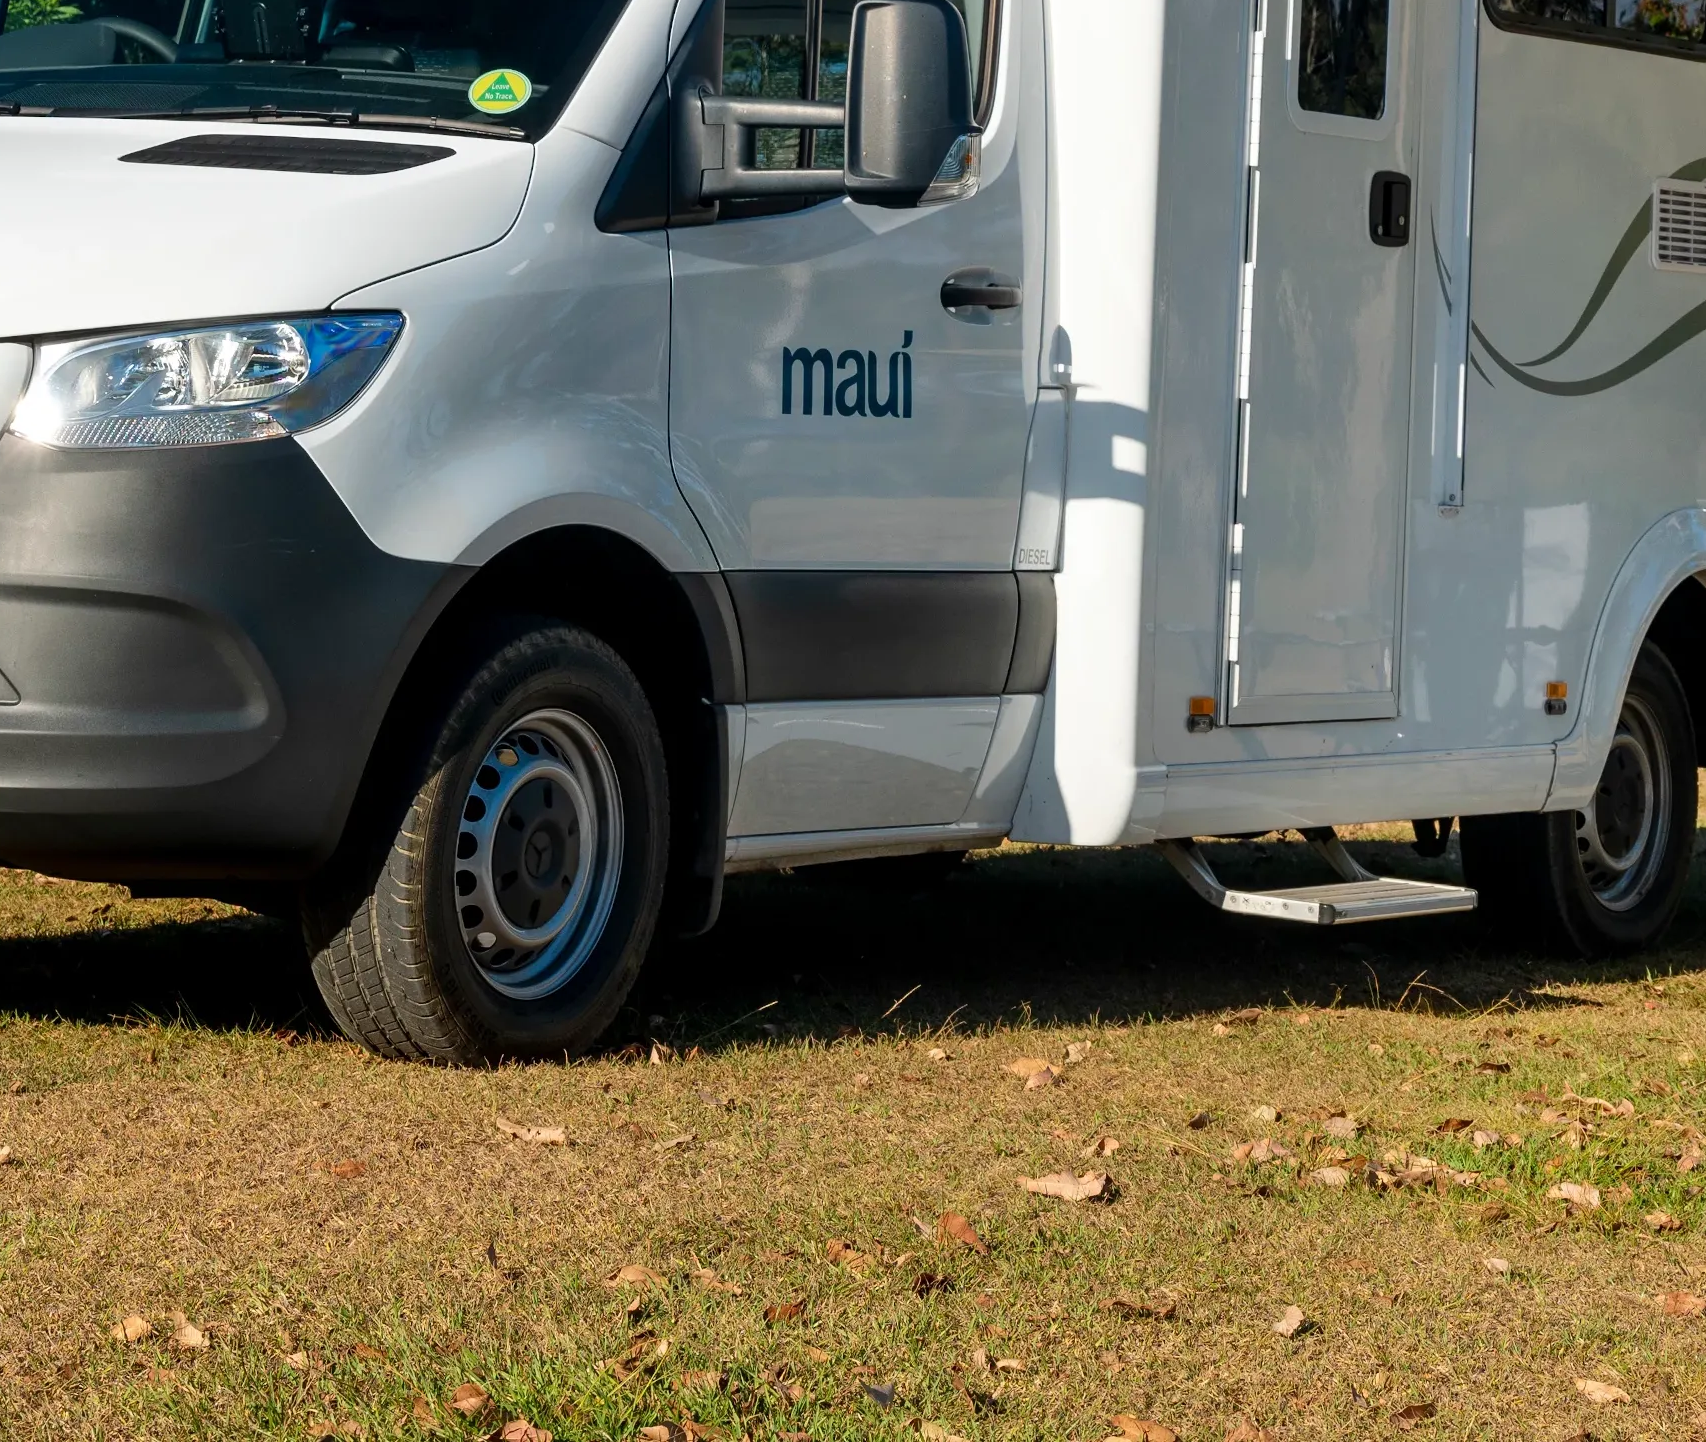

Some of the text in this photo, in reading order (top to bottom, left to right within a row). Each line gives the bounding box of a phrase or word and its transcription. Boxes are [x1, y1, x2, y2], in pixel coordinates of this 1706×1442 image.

[484, 92, 513, 100] No Trace
[1018, 548, 1051, 566] DIESEL
